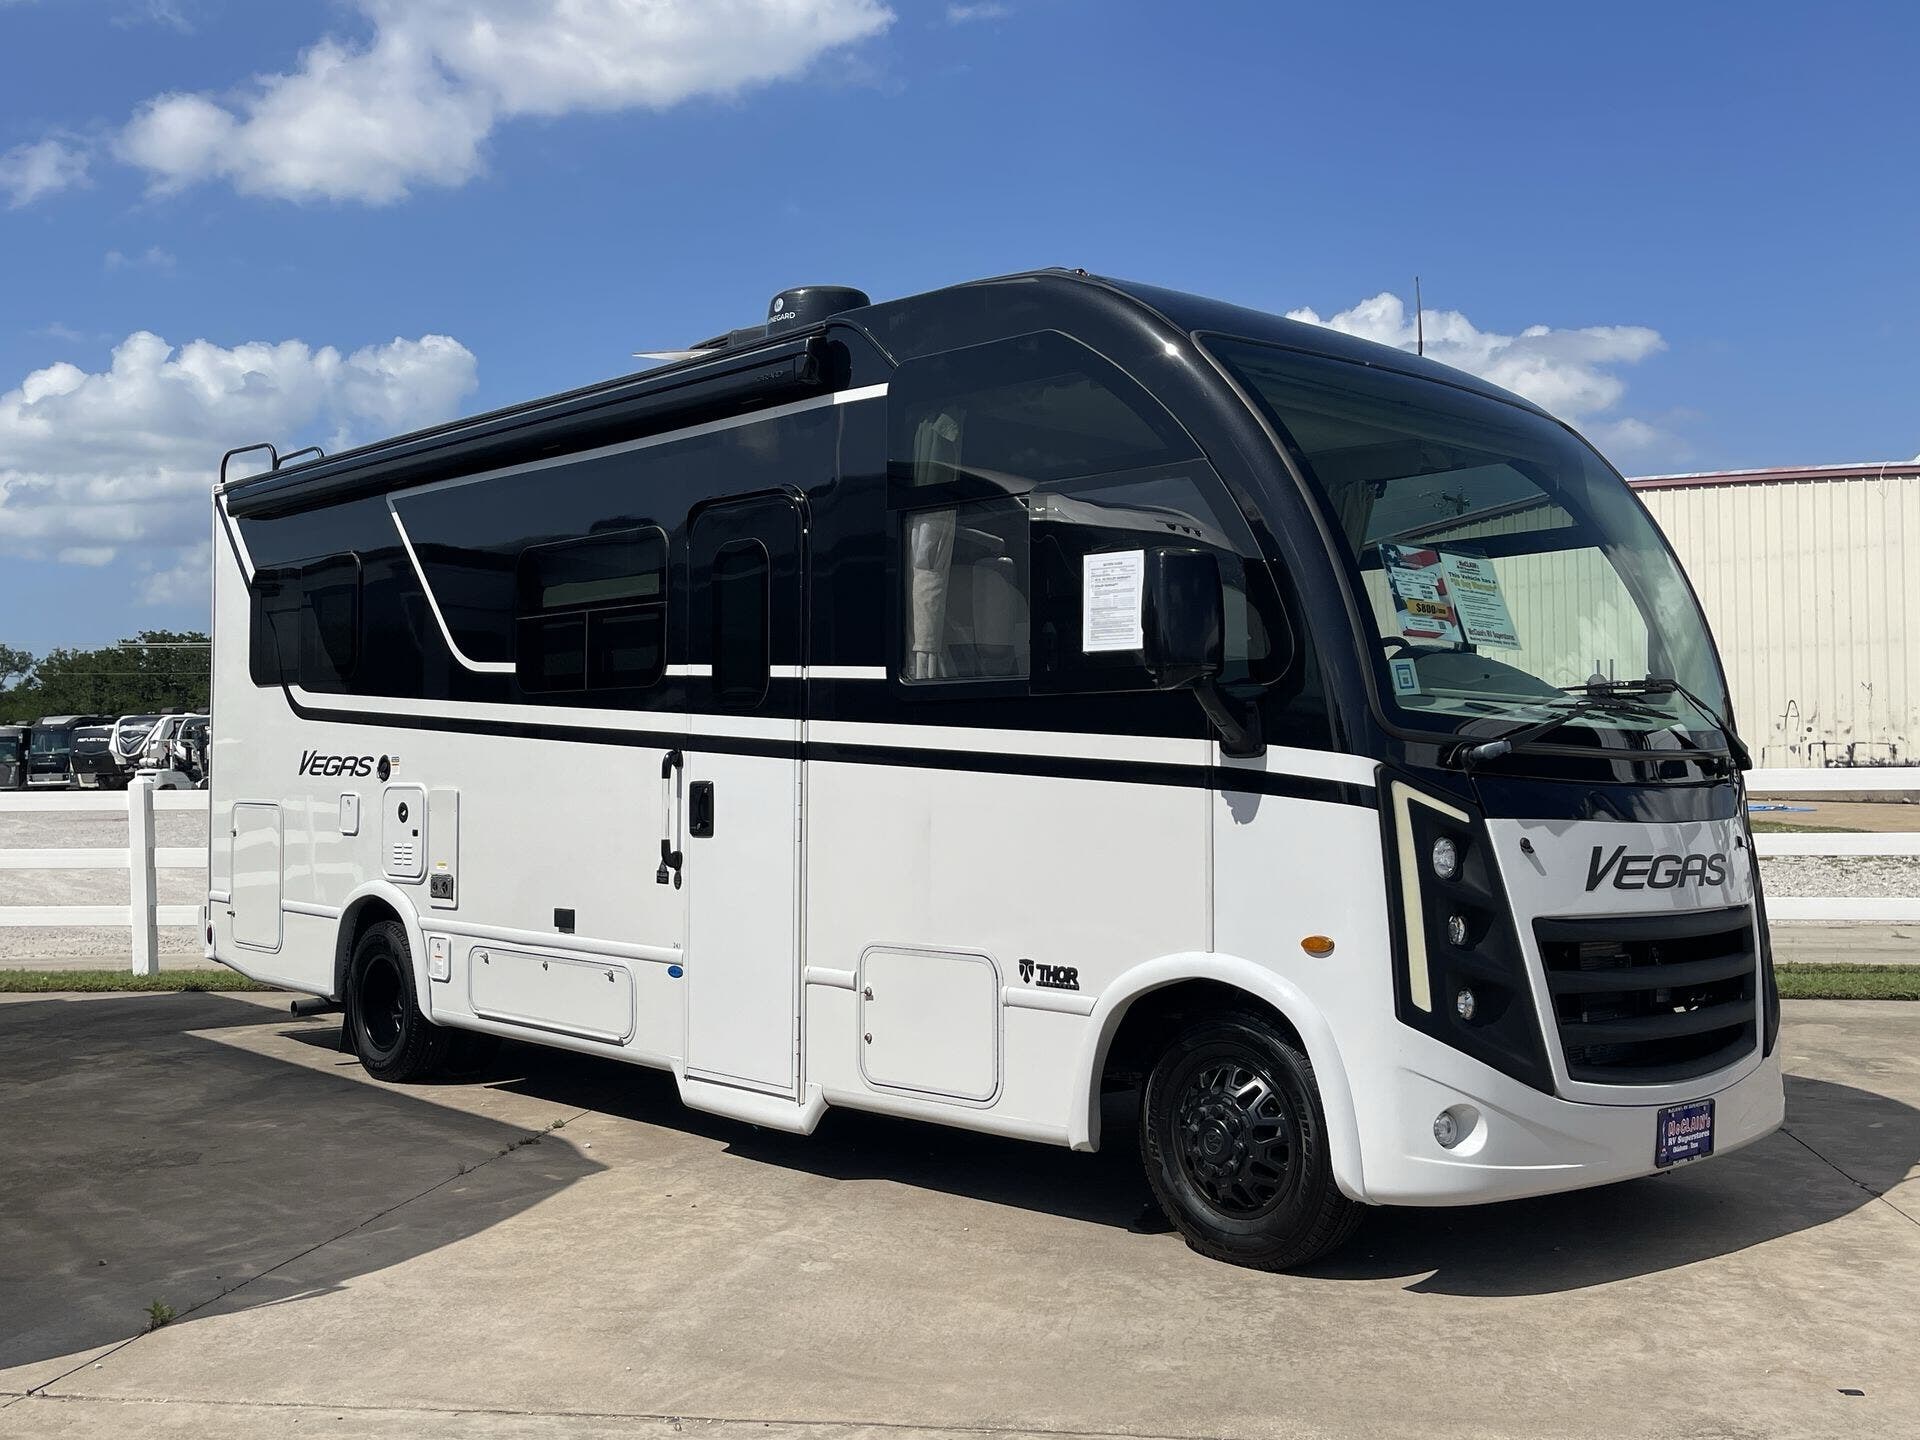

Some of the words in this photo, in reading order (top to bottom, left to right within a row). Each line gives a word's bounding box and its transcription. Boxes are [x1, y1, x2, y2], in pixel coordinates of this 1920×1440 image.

[299, 750, 374, 776] VEGAS
[1585, 845, 1726, 892] VEGAS
[1036, 963, 1079, 985] THOR
[1668, 1137, 1677, 1146] RV
